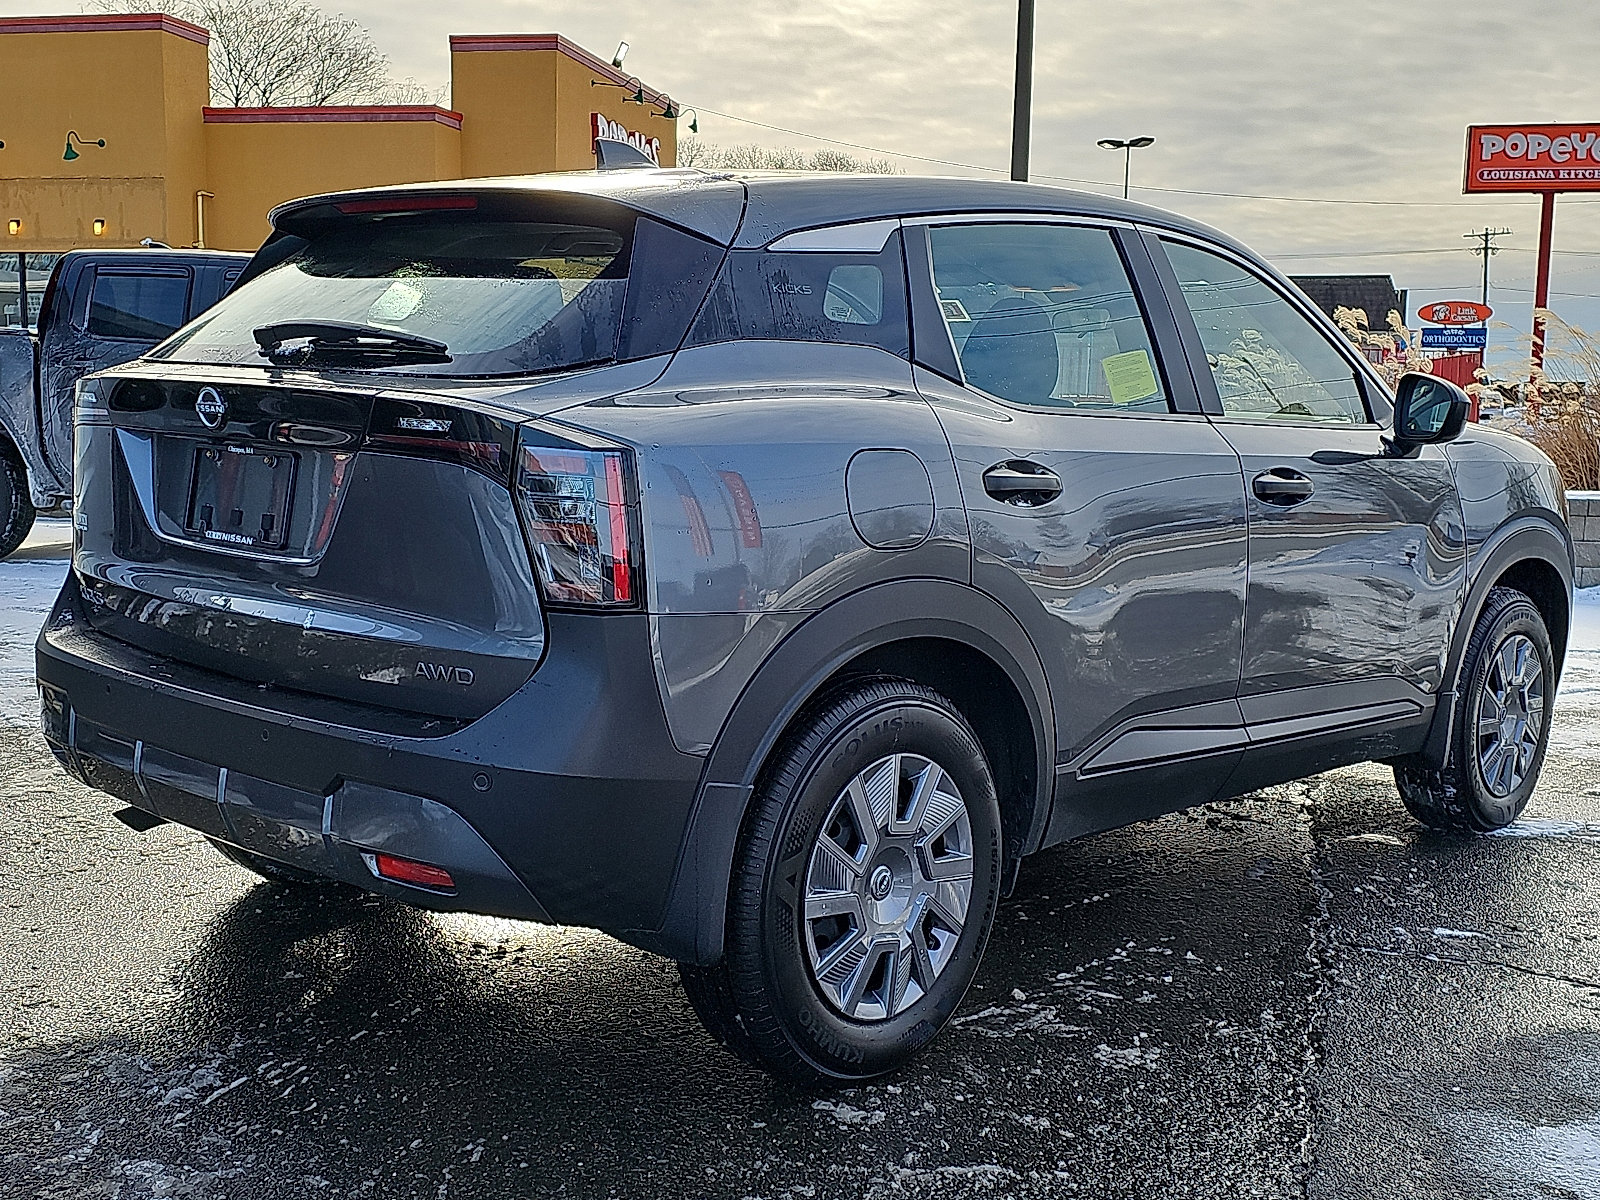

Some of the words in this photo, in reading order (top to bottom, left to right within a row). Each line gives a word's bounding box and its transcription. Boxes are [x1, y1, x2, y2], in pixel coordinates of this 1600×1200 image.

[1482, 170, 1555, 179] LOUISIANA
[772, 283, 812, 295] KICKS
[1423, 335, 1485, 343] ORTHODONTICS
[221, 532, 254, 545] NISSAN
[414, 661, 475, 686] AWD
[798, 1009, 865, 1064] KUMHO
